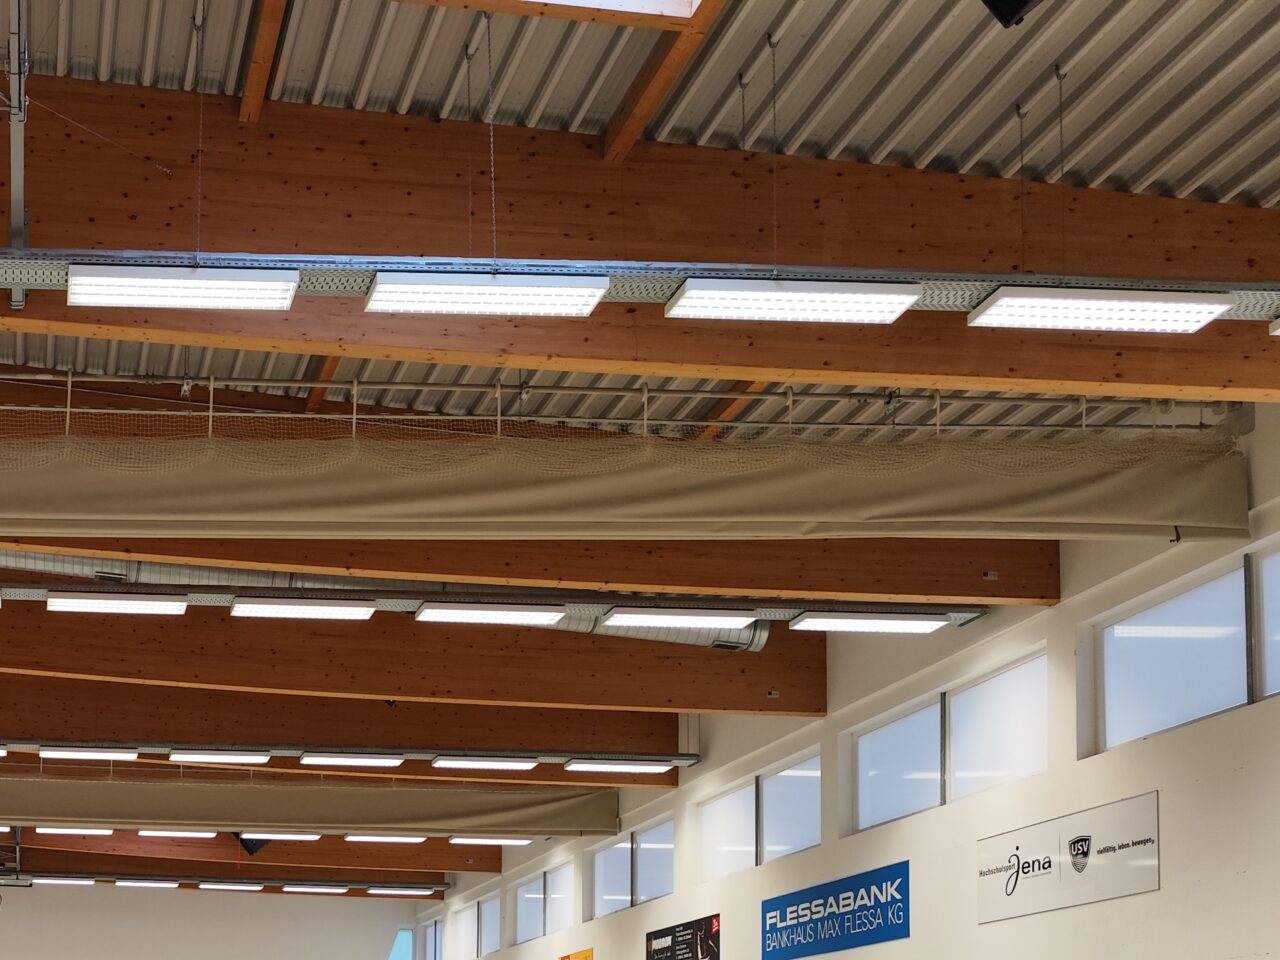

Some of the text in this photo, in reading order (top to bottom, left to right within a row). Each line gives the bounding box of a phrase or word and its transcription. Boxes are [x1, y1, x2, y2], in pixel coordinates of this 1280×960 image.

[1070, 840, 1089, 855] USV
[766, 877, 903, 931] FLESSABANK
[766, 902, 904, 952] BANKHAUS MAX FLESSA KG
